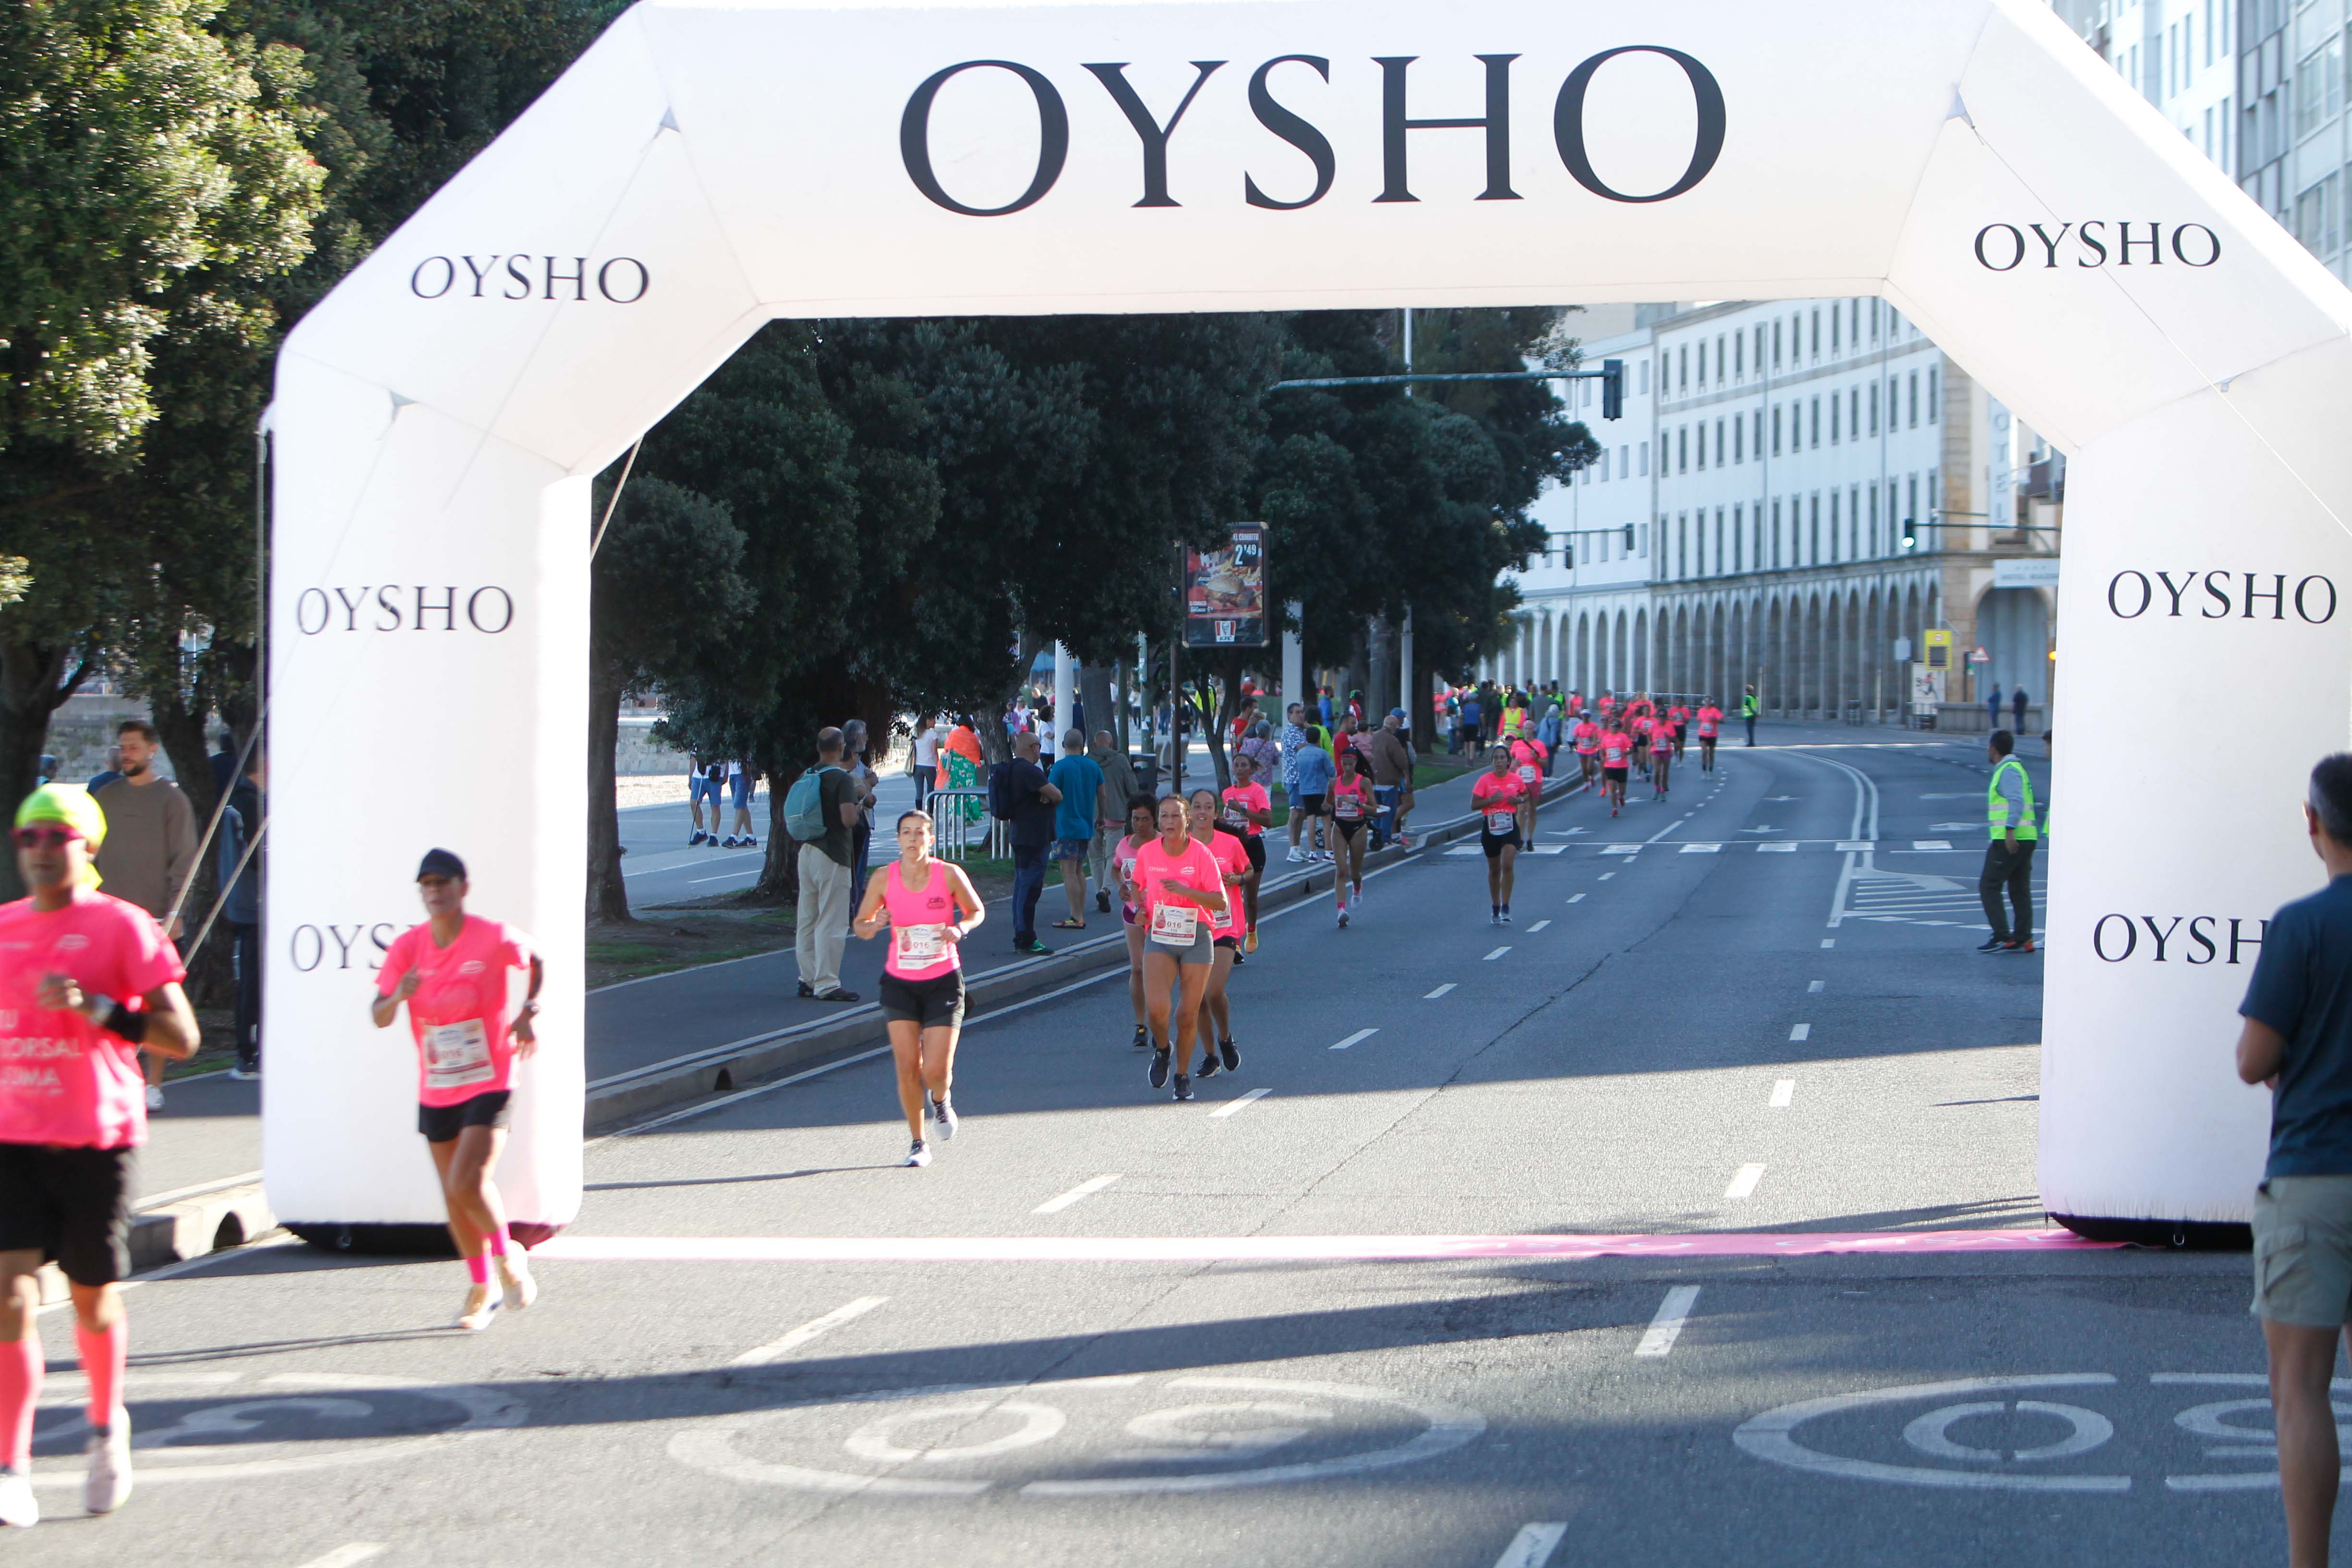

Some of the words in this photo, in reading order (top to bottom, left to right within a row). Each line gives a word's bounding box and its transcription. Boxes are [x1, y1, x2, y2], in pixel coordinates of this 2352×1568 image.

[900, 45, 1727, 217] OYSHO
[1974, 220, 2221, 271] OYSHO
[411, 255, 649, 301] OYSHO
[1993, 400, 2009, 523] OTEL
[296, 585, 514, 636] OYSHO
[2107, 570, 2337, 625] OYSHO
[290, 921, 416, 972] OYS
[2093, 913, 2269, 965] OYSH
